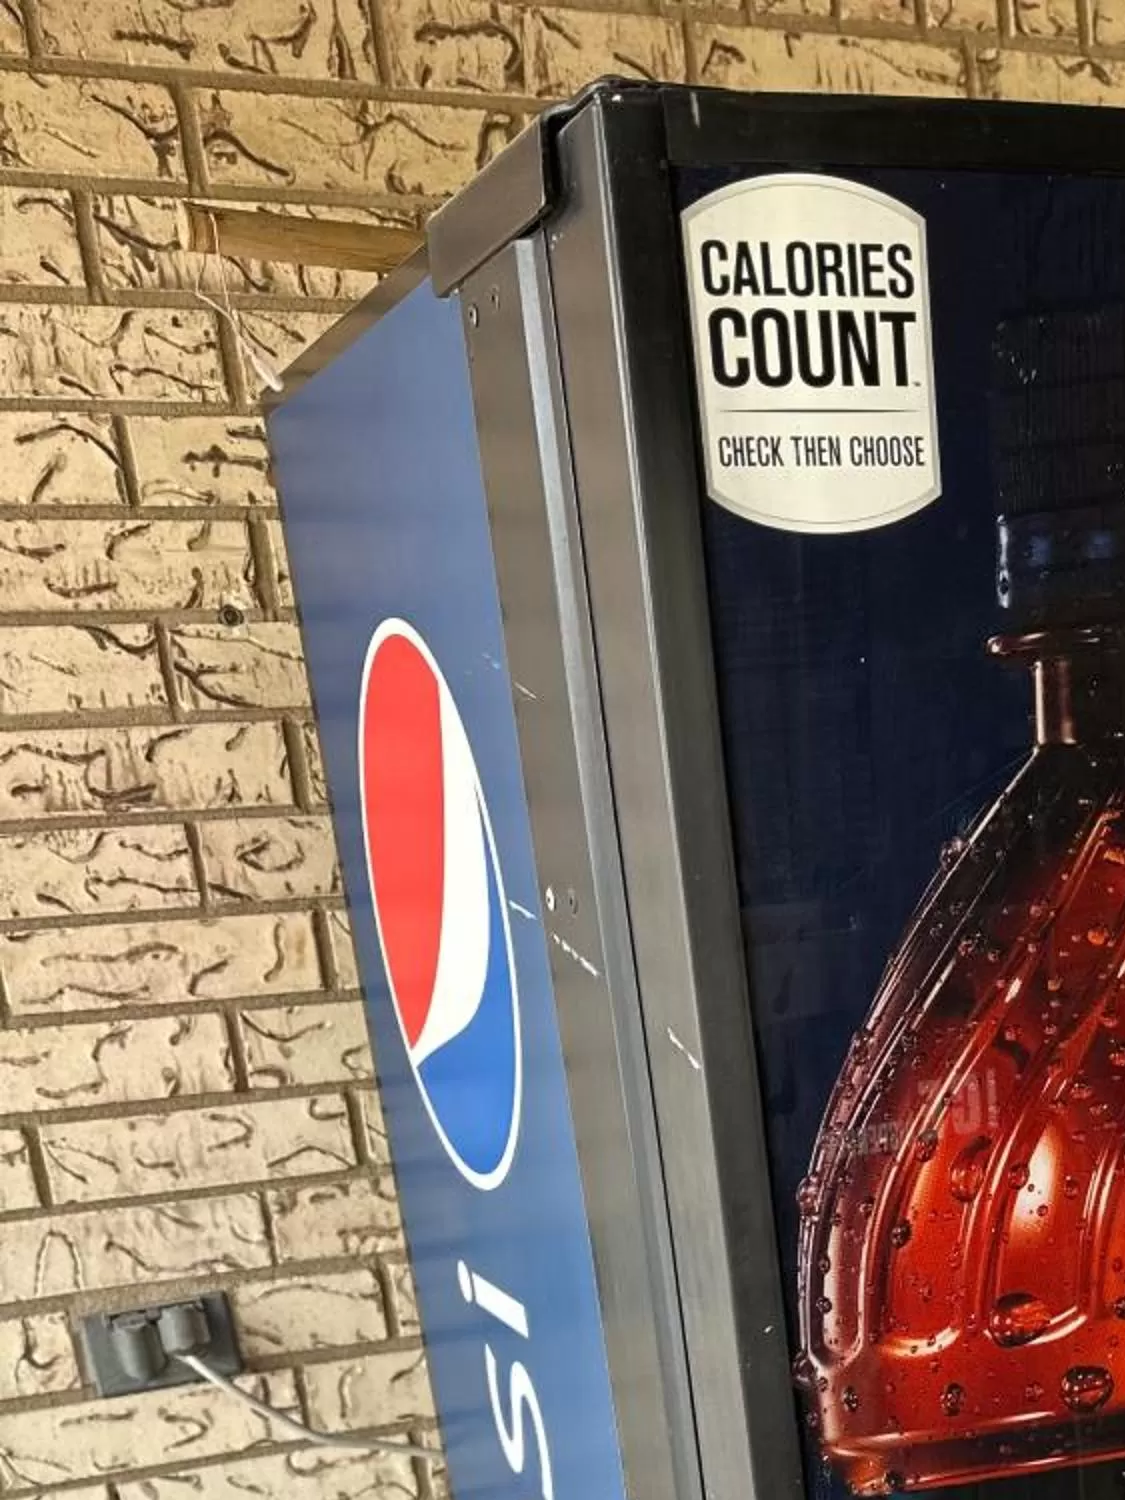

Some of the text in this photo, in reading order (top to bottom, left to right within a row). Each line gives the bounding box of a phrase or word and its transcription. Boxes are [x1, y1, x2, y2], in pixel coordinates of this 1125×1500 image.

[701, 239, 915, 299] CALORIES
[708, 307, 916, 388] COUNT
[719, 435, 925, 468] CHECK THEN CHOOSE
